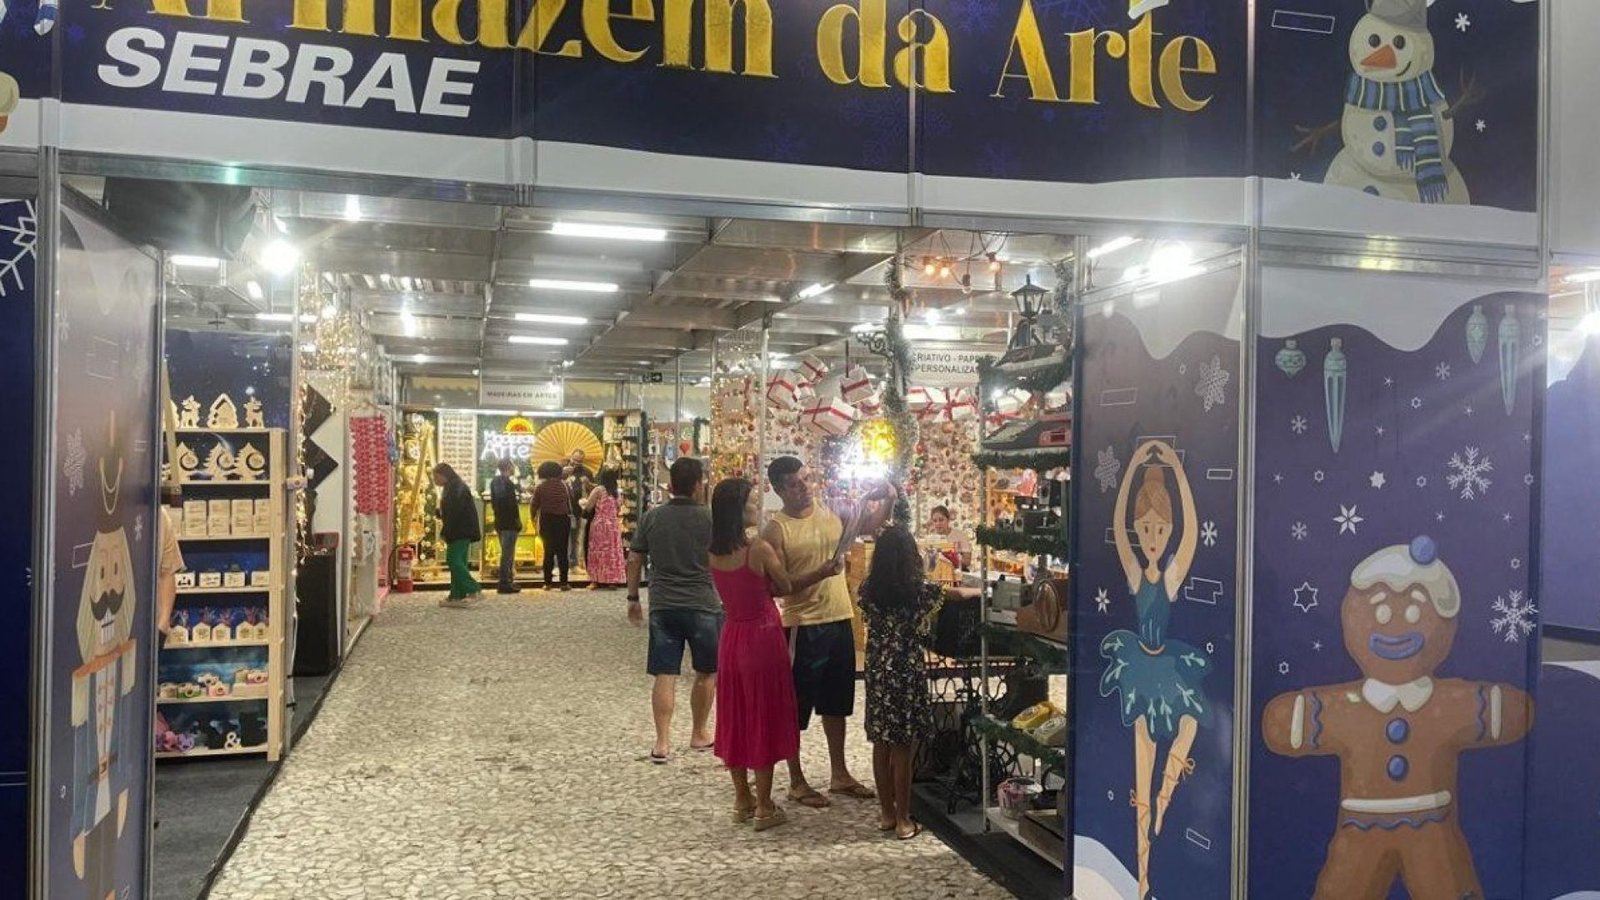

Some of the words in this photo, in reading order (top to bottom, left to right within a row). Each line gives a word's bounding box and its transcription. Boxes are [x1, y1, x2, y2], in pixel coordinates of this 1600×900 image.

[97, 26, 481, 118] SEBRAE
[816, 0, 955, 93] da
[990, 0, 1218, 112] Arte
[481, 439, 531, 460] Arte
